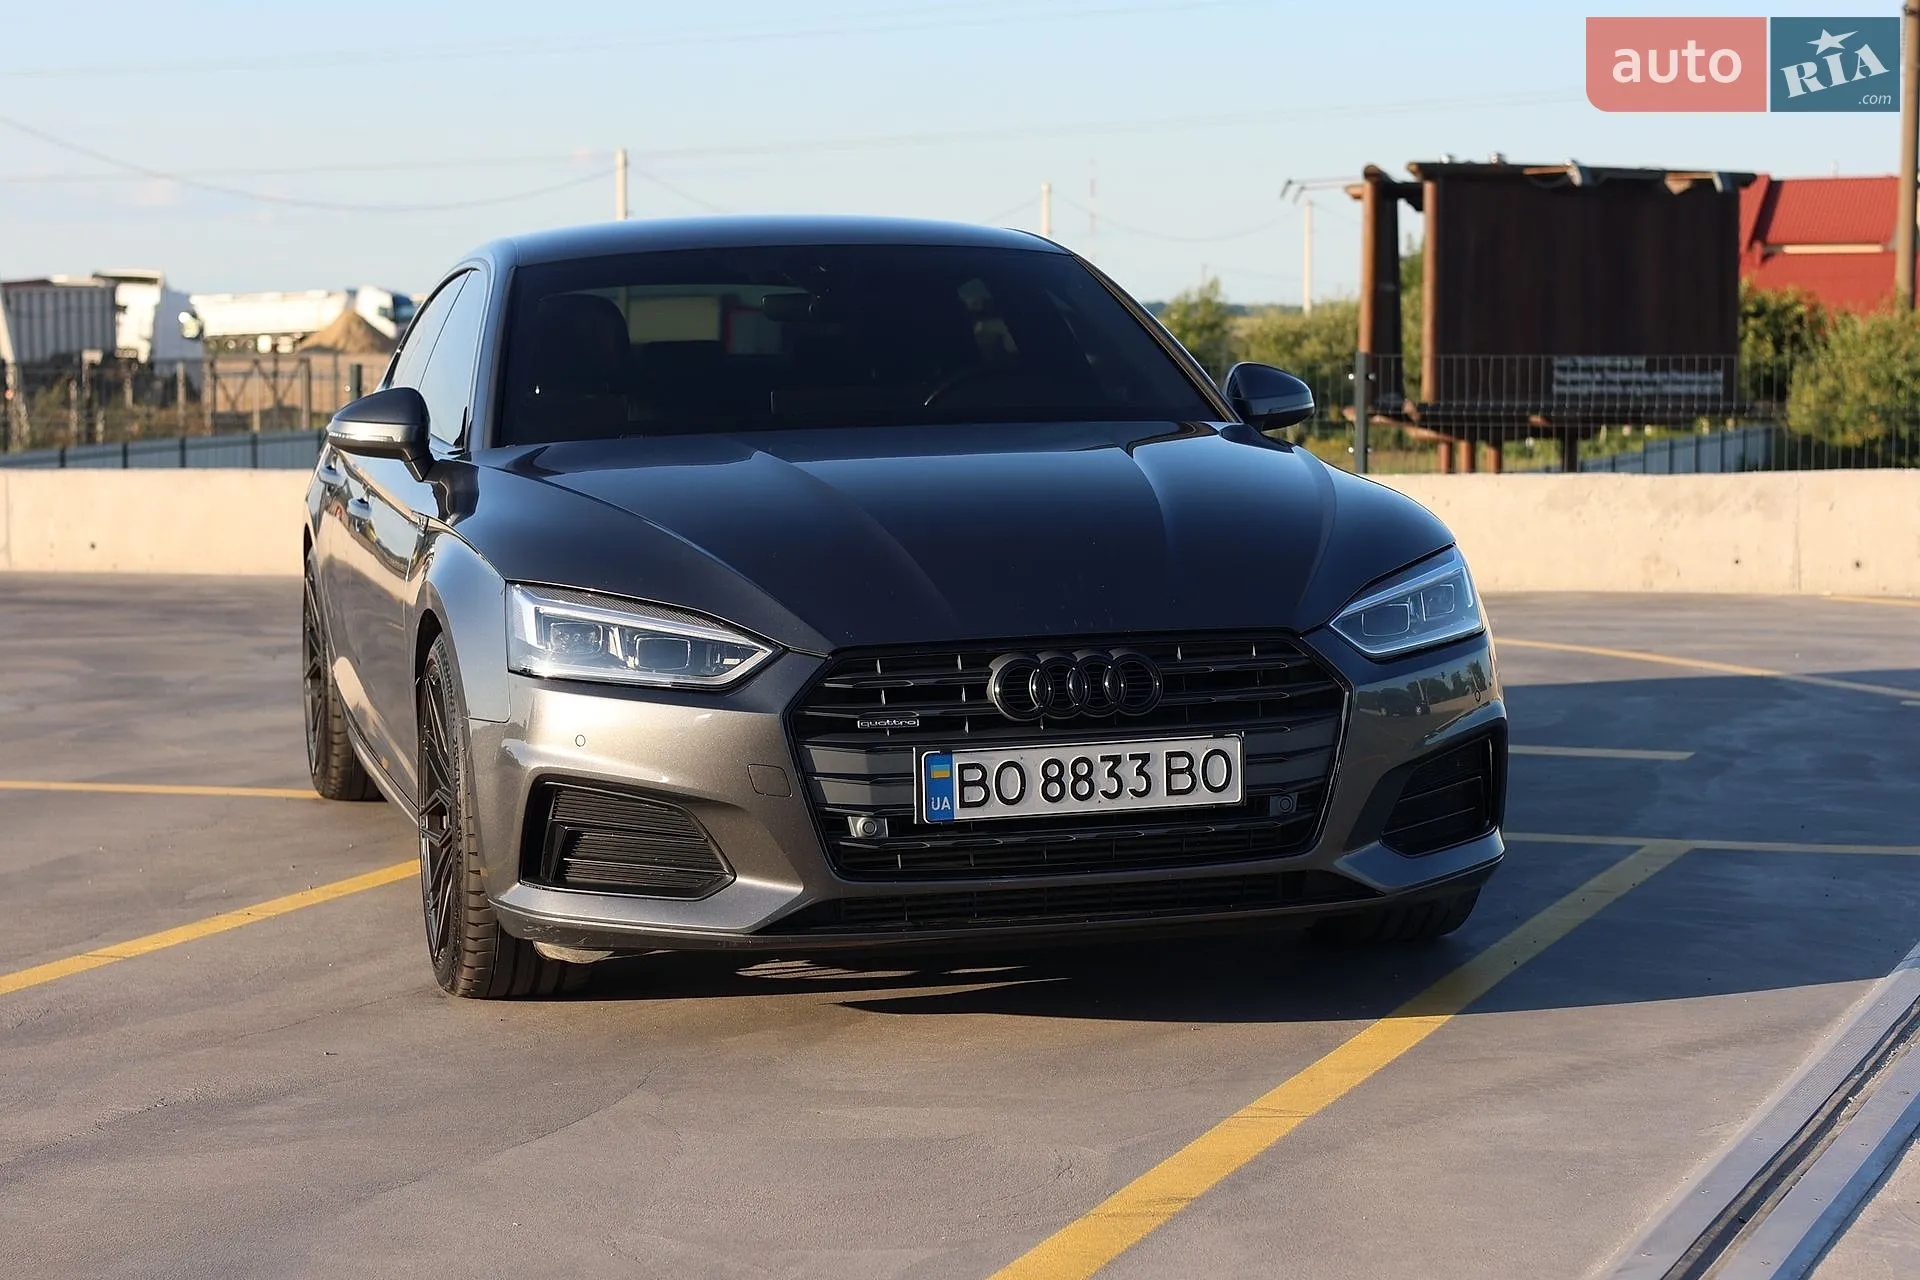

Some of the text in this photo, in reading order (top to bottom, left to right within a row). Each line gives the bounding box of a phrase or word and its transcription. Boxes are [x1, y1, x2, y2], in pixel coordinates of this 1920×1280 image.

[860, 719, 917, 728] quattro
[958, 748, 1233, 808] BO 8833 BO
[931, 796, 951, 811] UA
